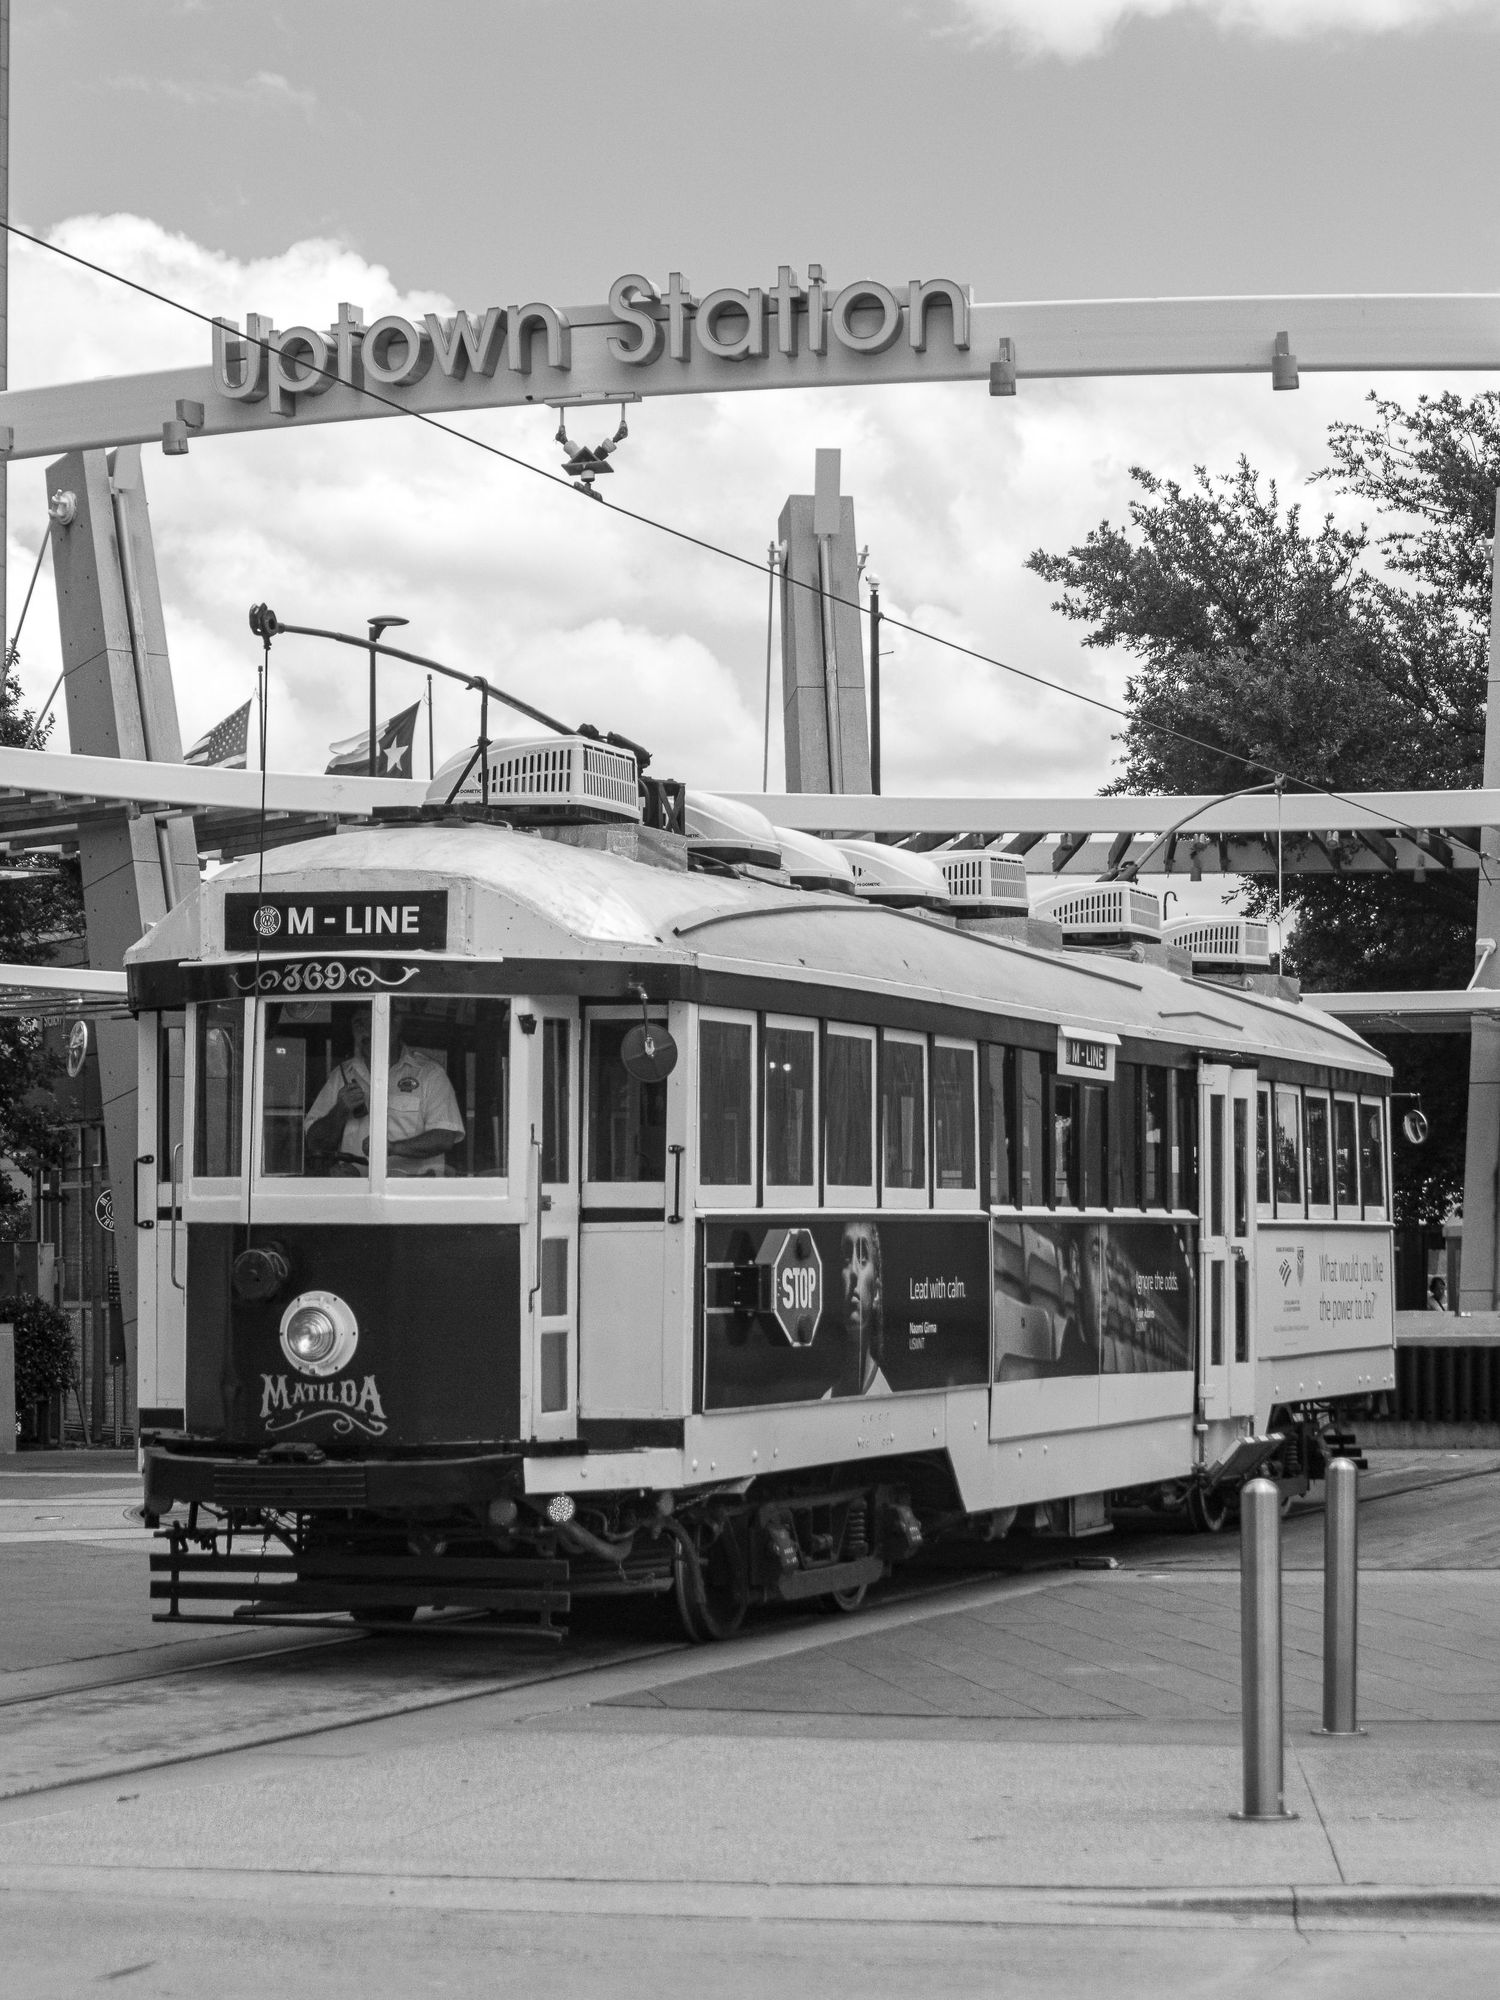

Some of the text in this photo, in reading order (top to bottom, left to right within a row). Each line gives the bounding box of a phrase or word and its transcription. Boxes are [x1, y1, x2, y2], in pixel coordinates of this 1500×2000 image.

[212, 263, 971, 416] Uptown Station
[282, 961, 347, 991] 369
[782, 1267, 816, 1309] STOP
[909, 1275, 966, 1300] Lead with calm.
[1135, 1270, 1179, 1296] Ignore the odds.
[1318, 1253, 1338, 1282] What
[1339, 1254, 1358, 1282] would
[1359, 1262, 1371, 1290] you
[1372, 1254, 1384, 1282] like
[1319, 1291, 1377, 1328] the power to do?
[259, 1373, 387, 1419] MATILDA
